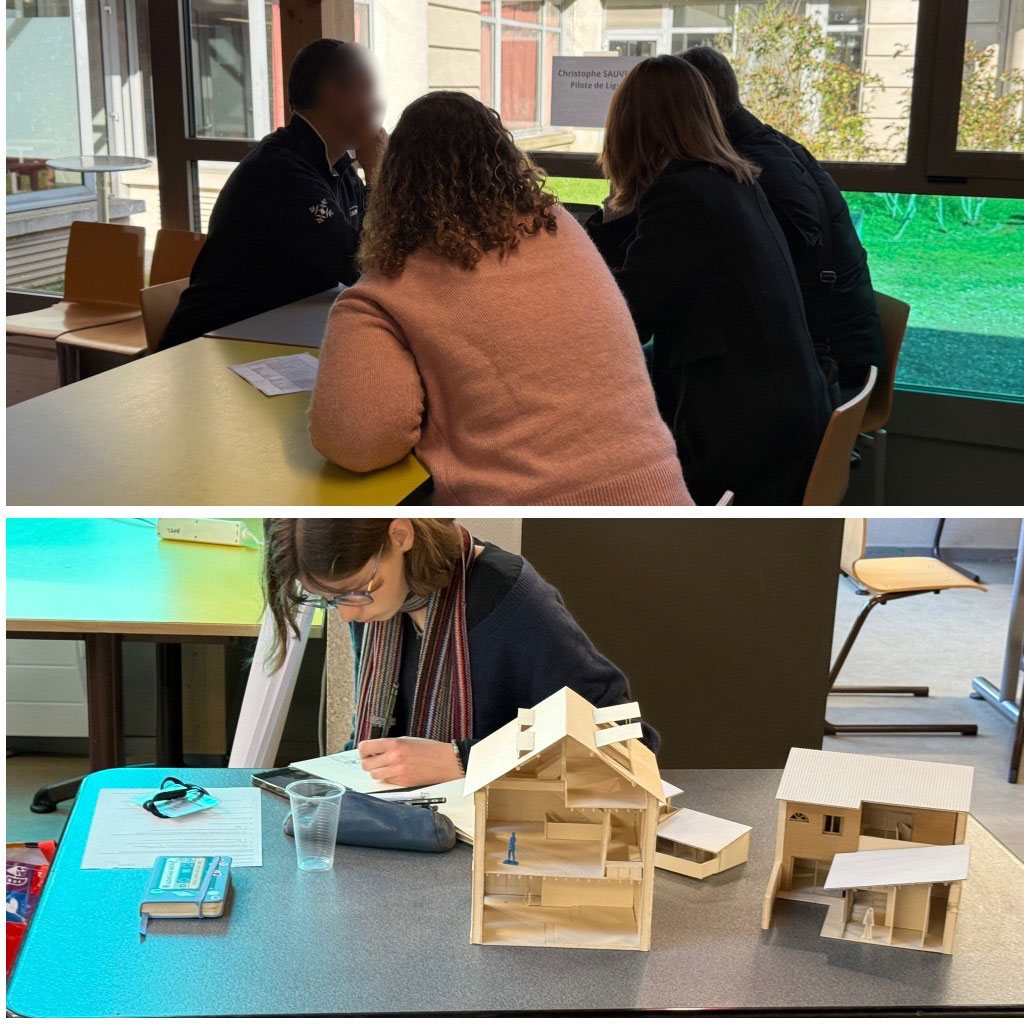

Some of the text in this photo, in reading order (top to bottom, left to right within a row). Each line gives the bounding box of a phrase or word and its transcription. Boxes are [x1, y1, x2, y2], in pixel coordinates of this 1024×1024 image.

[558, 70, 601, 79] Christophe
[570, 81, 592, 89] Pilote
[594, 81, 604, 89] de
